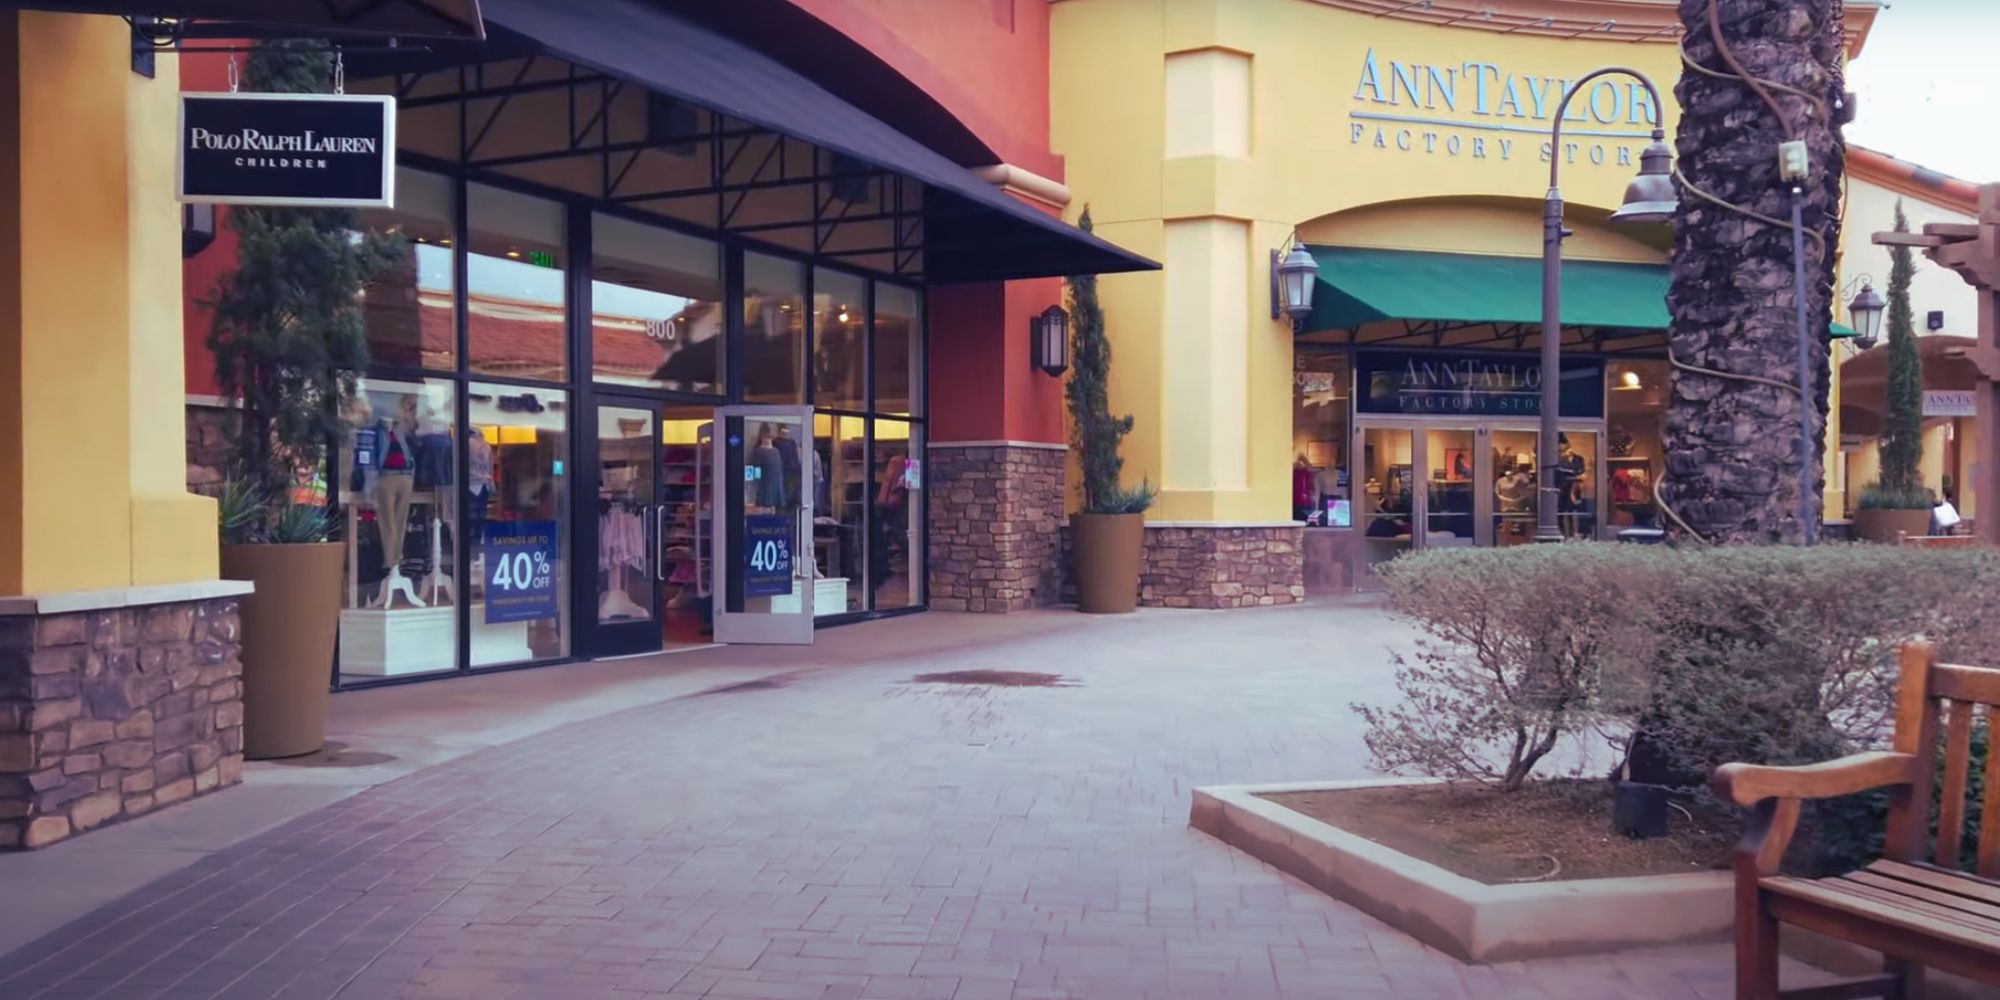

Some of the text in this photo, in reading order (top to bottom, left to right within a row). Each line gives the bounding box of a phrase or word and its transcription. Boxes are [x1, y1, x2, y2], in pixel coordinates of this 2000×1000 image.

[190, 127, 376, 153] POLO RALPH LAUREN
[1351, 123, 1632, 166] FACTORY STOR
[235, 157, 327, 169] CHILDREN
[646, 319, 676, 340] 800
[1401, 357, 1542, 389] ANNTAYLO
[1399, 396, 1542, 409] FACTORY STO
[776, 561, 788, 570] OFF
[532, 576, 550, 588] OFF
